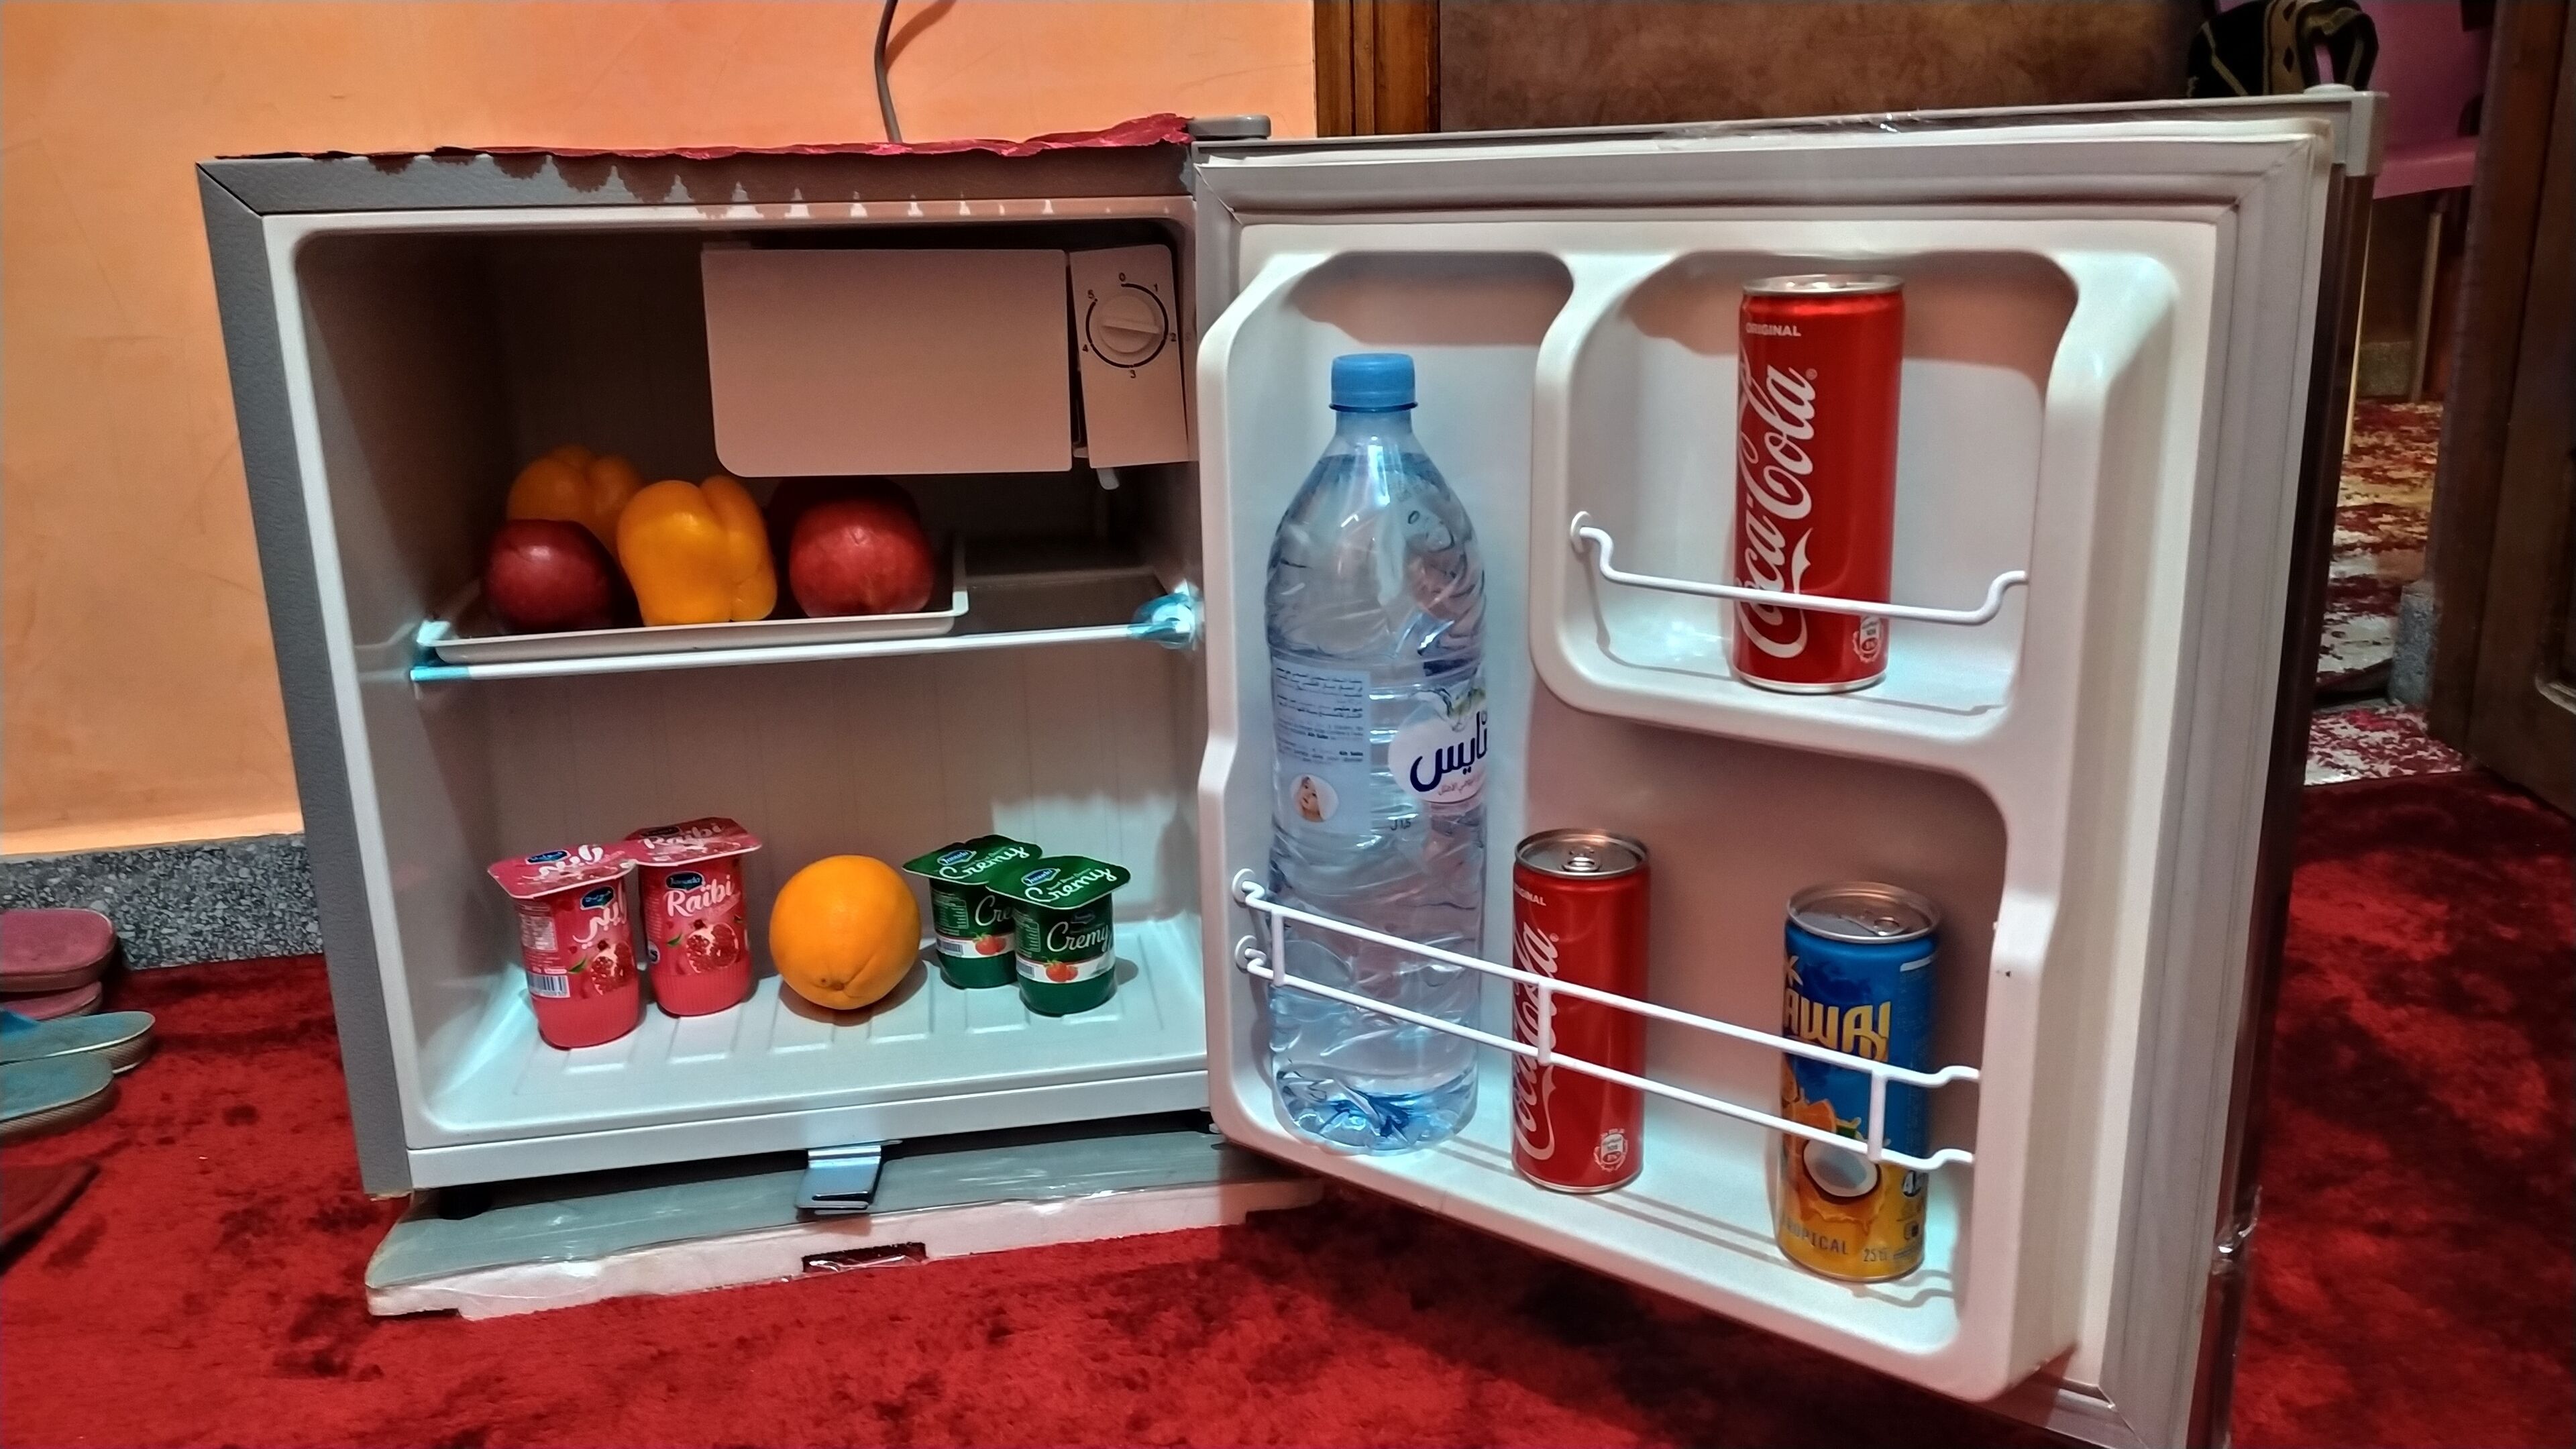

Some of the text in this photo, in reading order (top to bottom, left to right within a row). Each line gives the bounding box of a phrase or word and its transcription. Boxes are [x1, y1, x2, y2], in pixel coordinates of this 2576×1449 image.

[1118, 272, 1126, 282] 0
[1087, 290, 1095, 299] 5
[1153, 283, 1159, 292] 1
[1746, 322, 1802, 337] ORIGINAL
[1171, 333, 1177, 342] 2
[1082, 344, 1089, 353] 4
[1129, 370, 1136, 379] 3
[938, 846, 1030, 879] Cremy
[1024, 868, 1118, 902] Cremy
[663, 874, 733, 917] Raïbi
[975, 895, 1014, 926] Cre
[1046, 922, 1110, 953] Cremy
[1783, 987, 1891, 1062] AWAI
